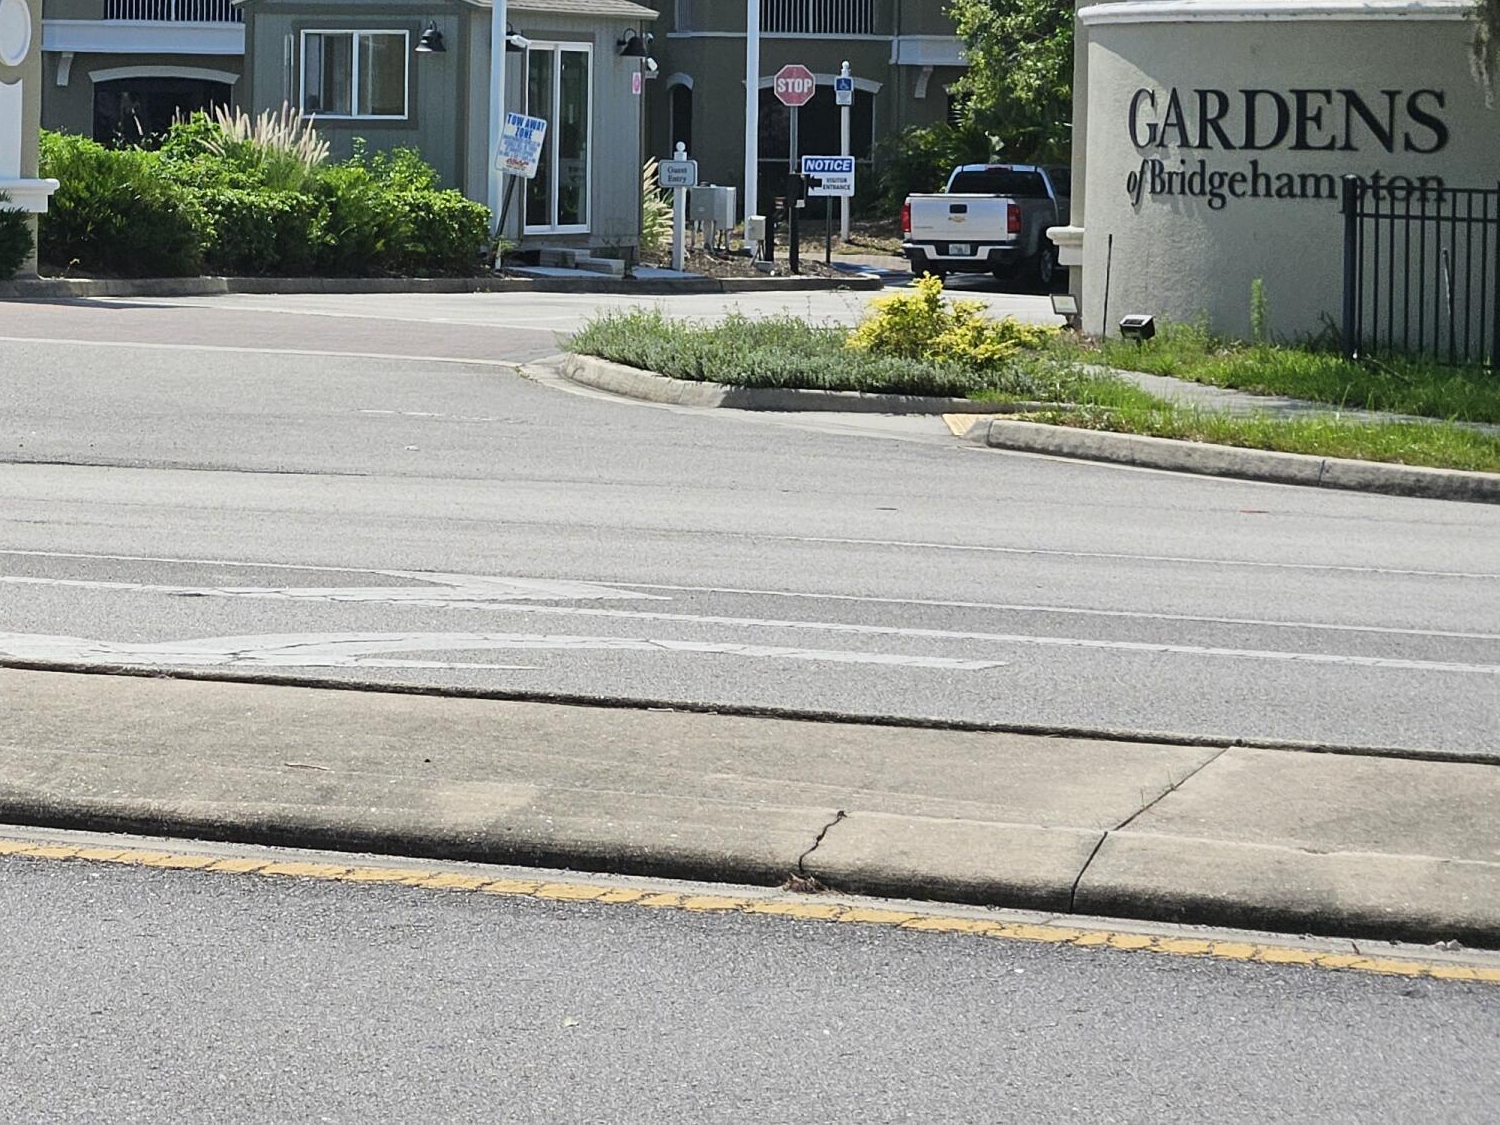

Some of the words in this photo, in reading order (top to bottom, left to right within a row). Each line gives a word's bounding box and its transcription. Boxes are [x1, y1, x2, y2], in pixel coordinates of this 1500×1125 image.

[777, 78, 812, 93] STOP
[507, 114, 525, 126] TOW
[525, 118, 545, 132] AWAY
[1128, 87, 1449, 154] GARDENS
[515, 127, 533, 140] ZONE
[667, 166, 687, 174] Guest
[805, 159, 851, 171] NOTICE
[667, 175, 687, 183] Entry
[1126, 159, 1148, 207] of
